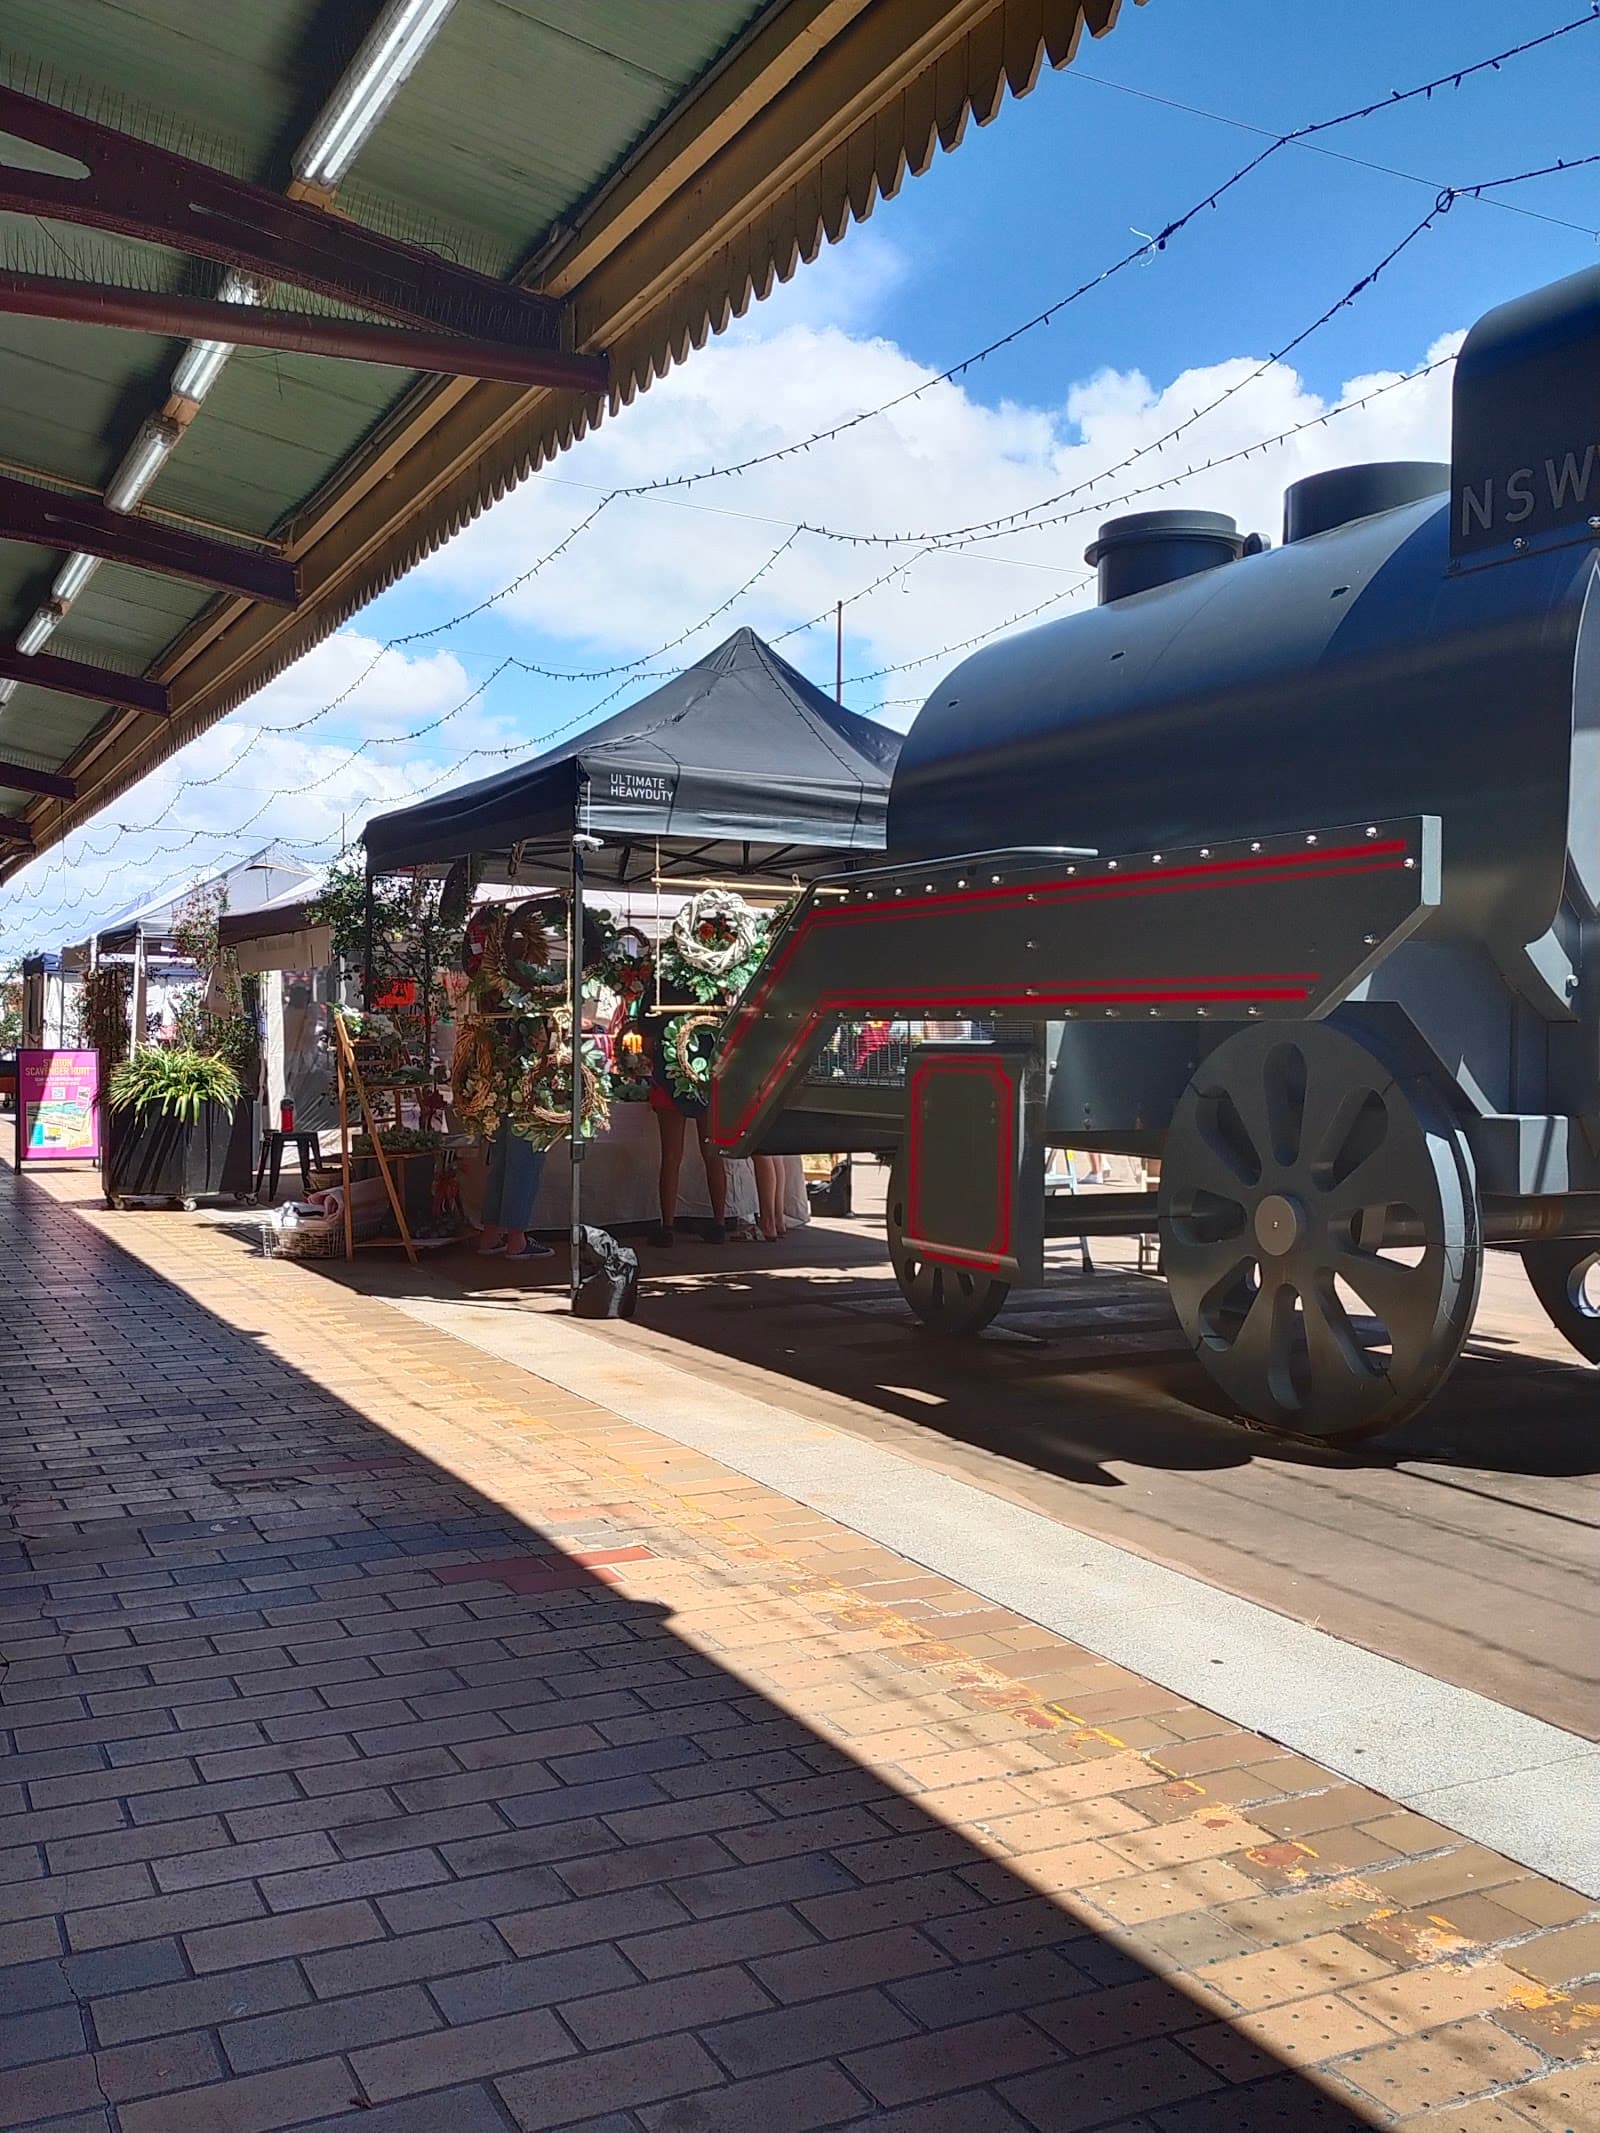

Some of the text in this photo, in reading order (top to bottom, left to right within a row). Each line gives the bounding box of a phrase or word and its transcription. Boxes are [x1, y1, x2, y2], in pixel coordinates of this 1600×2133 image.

[1462, 445, 1593, 536] NSW
[610, 773, 665, 789] ULTIMATE
[610, 785, 673, 801] HEAVYDUTY
